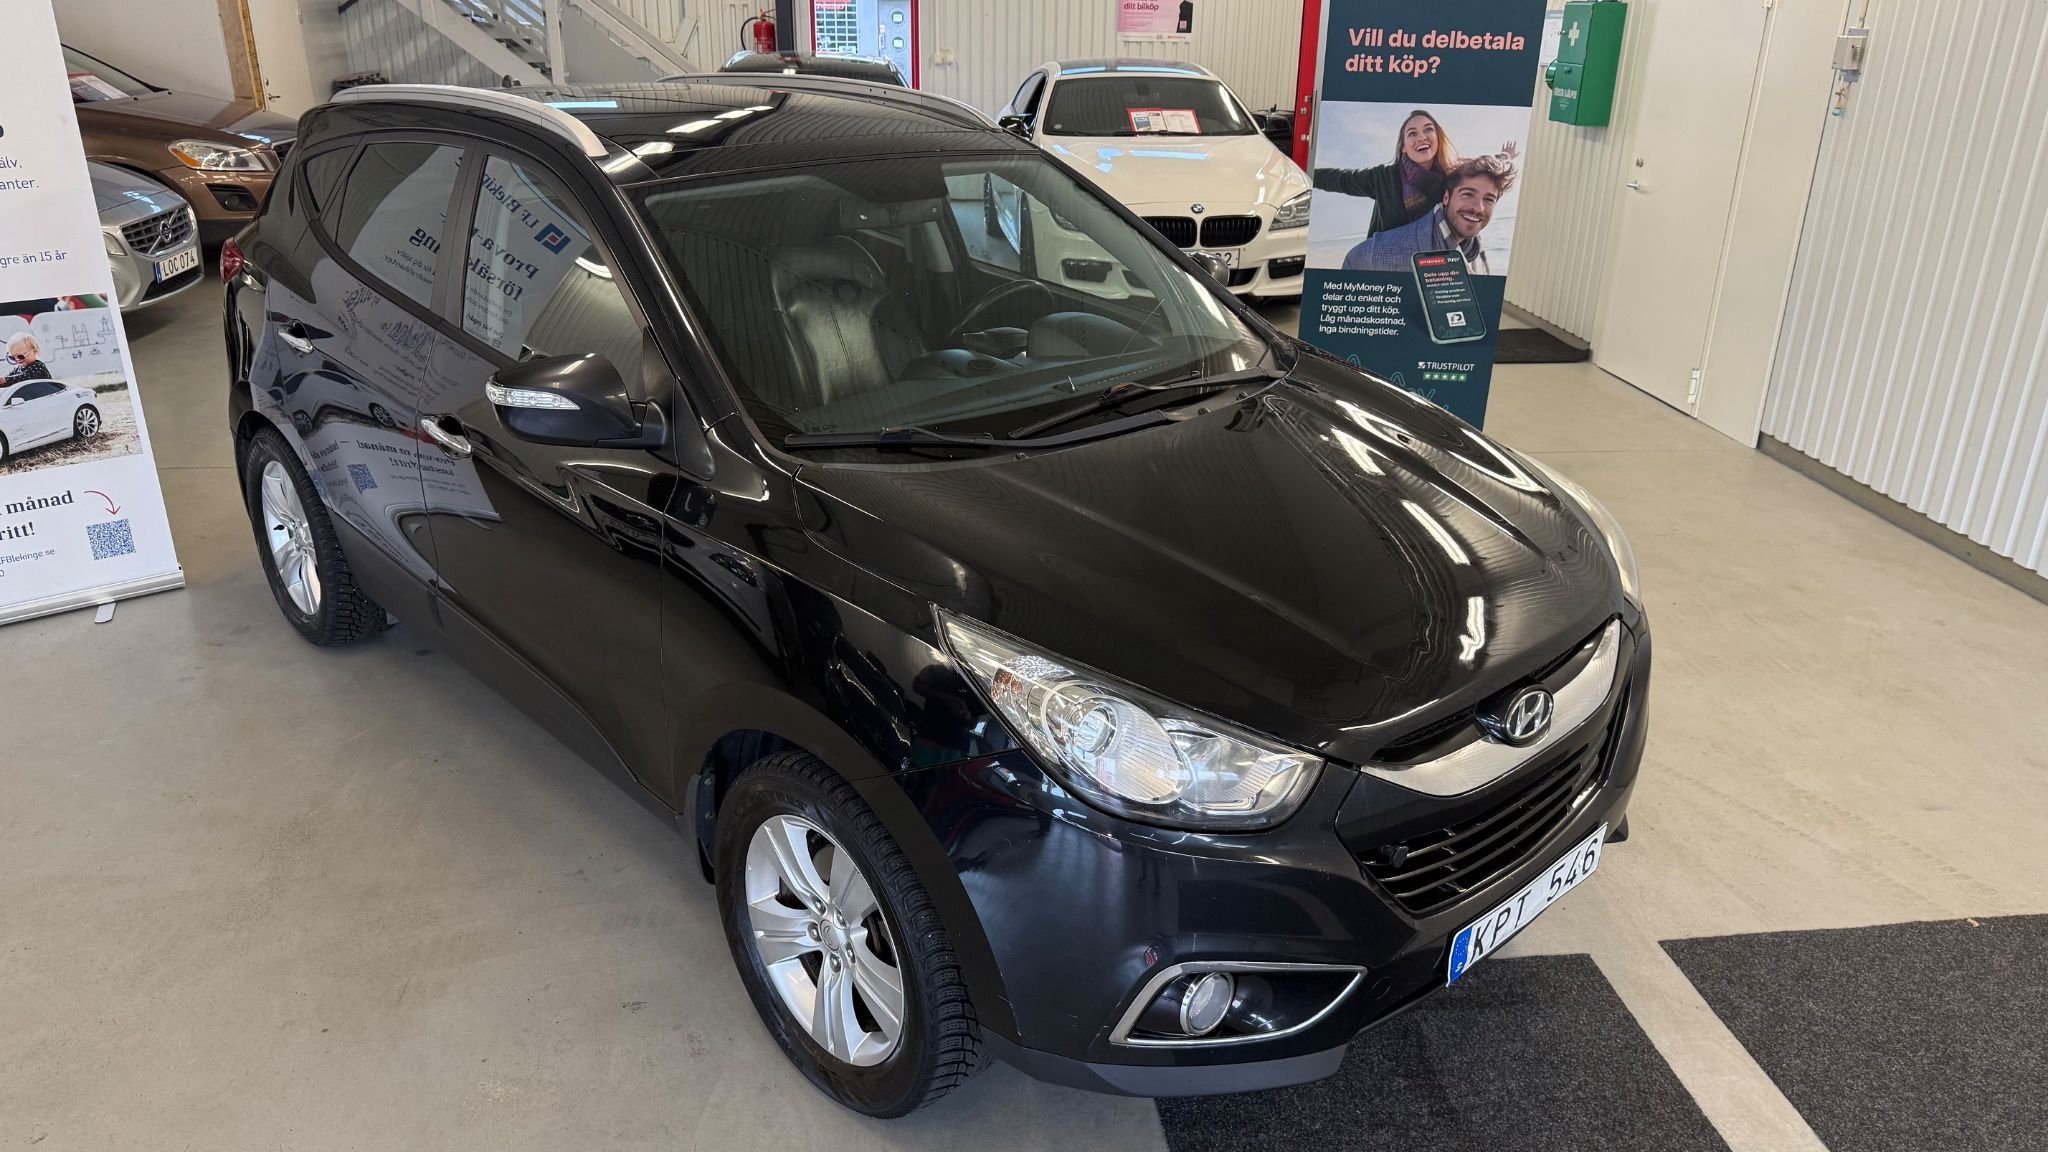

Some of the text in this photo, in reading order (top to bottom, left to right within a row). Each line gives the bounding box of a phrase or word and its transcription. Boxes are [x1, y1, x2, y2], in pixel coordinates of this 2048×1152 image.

[1137, 2, 1159, 12] bilköp
[1349, 28, 1525, 50] Vill du delbetala
[1345, 54, 1441, 78] ditt köp?
[0, 178, 39, 190] anter.
[23, 253, 37, 264] än
[40, 251, 52, 262] 15
[55, 250, 67, 261] år
[163, 250, 195, 277] LOC 074
[1323, 282, 1403, 294] Med MyMoney Pay
[1322, 293, 1401, 303] delar du enkelt och
[1321, 304, 1400, 315] tryggt upp ditt köp.
[1320, 314, 1406, 326] Låg månadskostnad,
[1338, 325, 1399, 336] bindningstider.
[1426, 362, 1475, 371] TRUSTPILOT
[5, 490, 75, 515] månad
[1469, 838, 1598, 964] KPT 546
